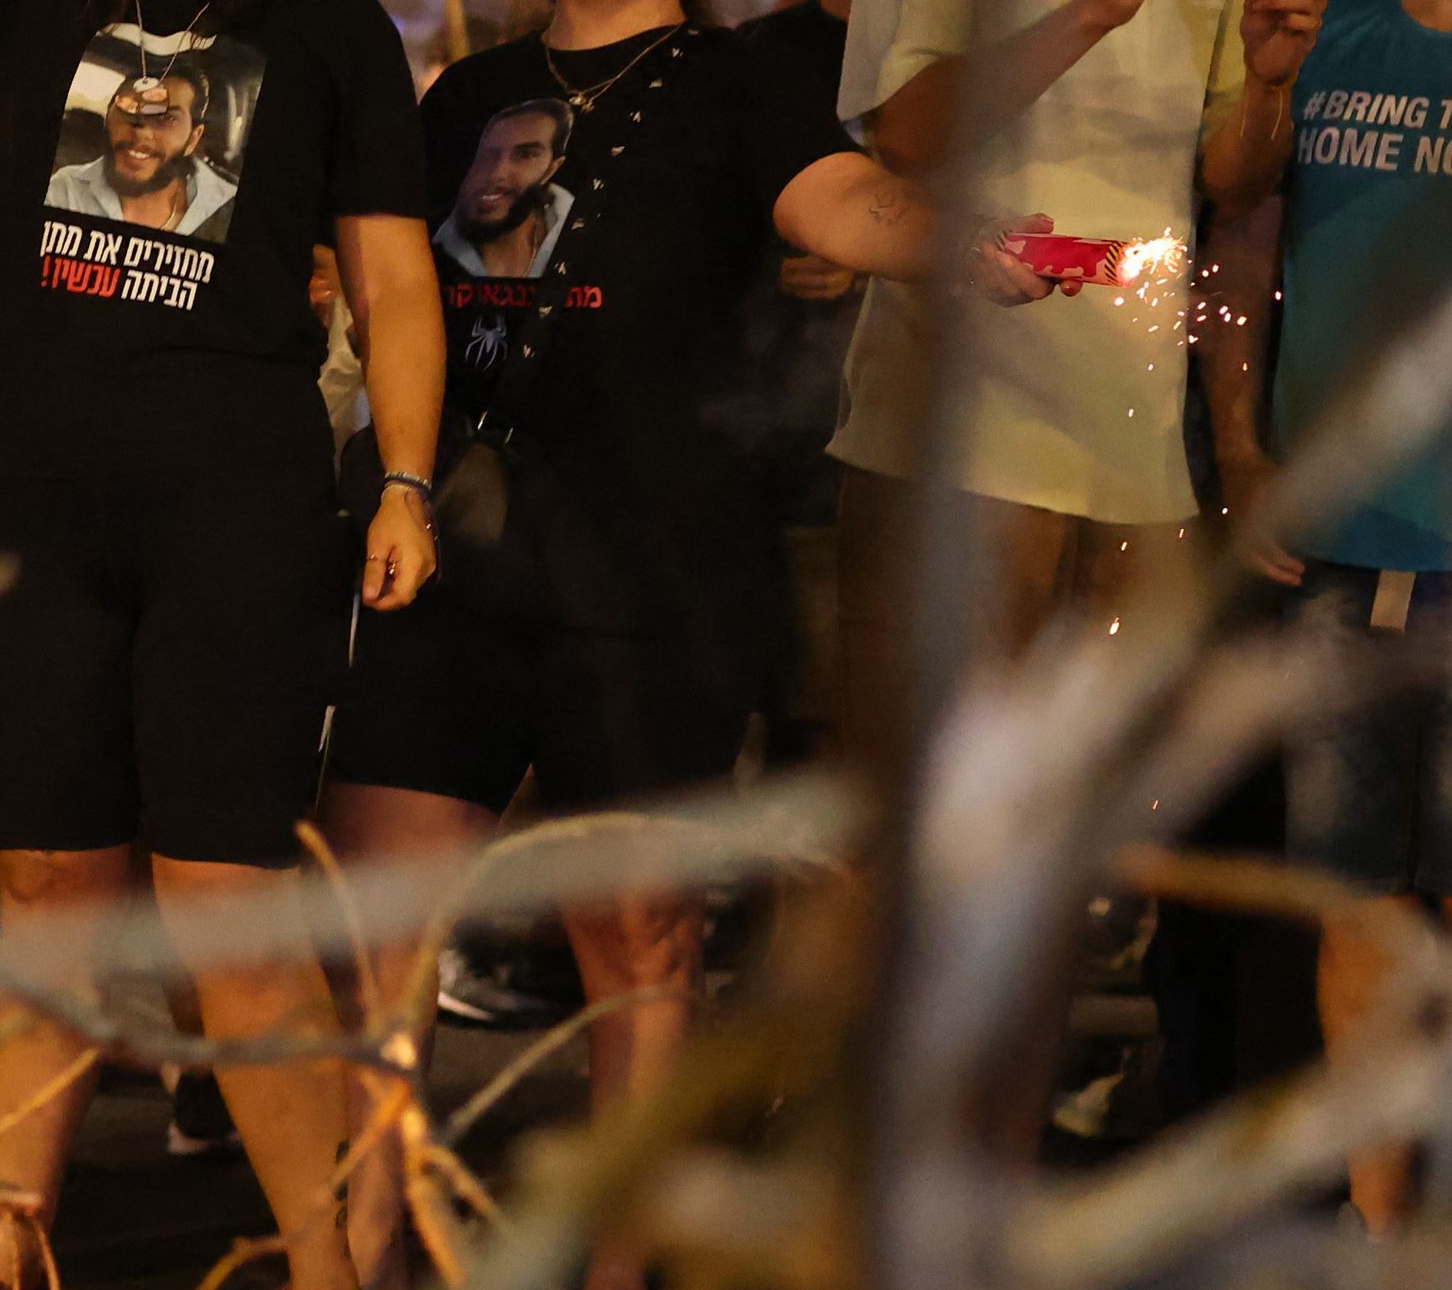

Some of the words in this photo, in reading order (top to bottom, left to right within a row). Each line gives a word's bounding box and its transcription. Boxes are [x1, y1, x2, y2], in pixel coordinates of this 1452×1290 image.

[1302, 90, 1430, 129] #BRING
[1297, 126, 1405, 172] HOME
[40, 220, 83, 257] מתן
[82, 230, 123, 266] את
[40, 255, 122, 299] עכשיו!
[123, 236, 215, 284] מחזירים
[120, 269, 199, 311] הביתה
